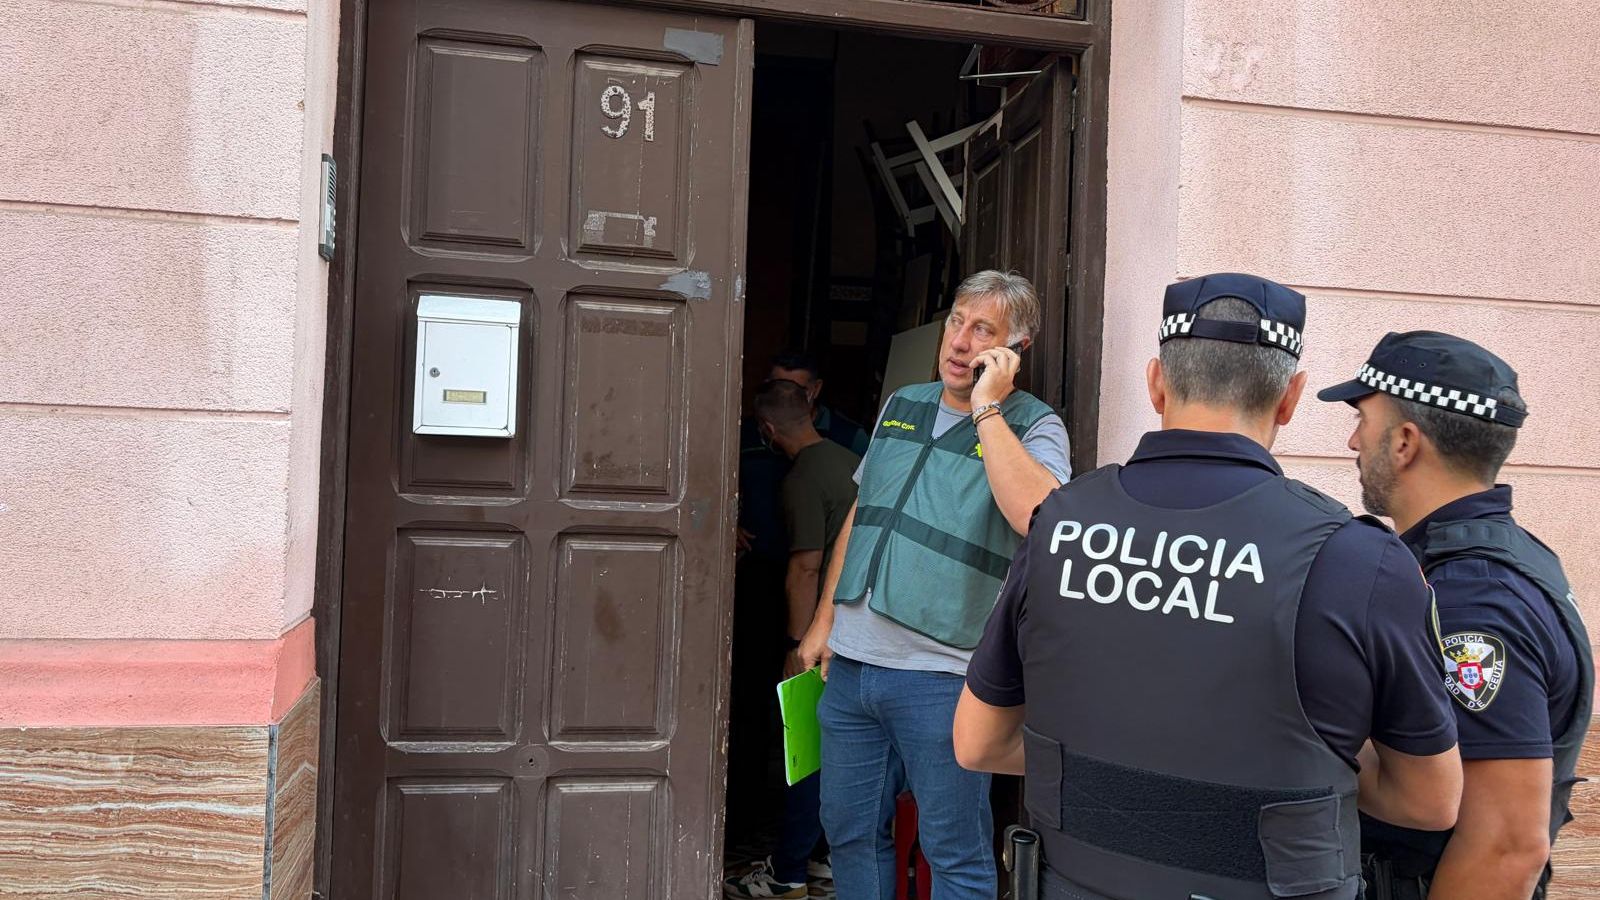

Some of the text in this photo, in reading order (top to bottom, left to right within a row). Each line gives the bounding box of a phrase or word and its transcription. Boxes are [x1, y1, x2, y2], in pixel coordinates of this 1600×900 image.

[600, 85, 656, 142] 91
[1049, 520, 1265, 584] POLICIA
[1059, 558, 1235, 624] LOCAL
[1444, 635, 1485, 647] POLICIA
[1444, 660, 1504, 708] DAD DE CEUTA
